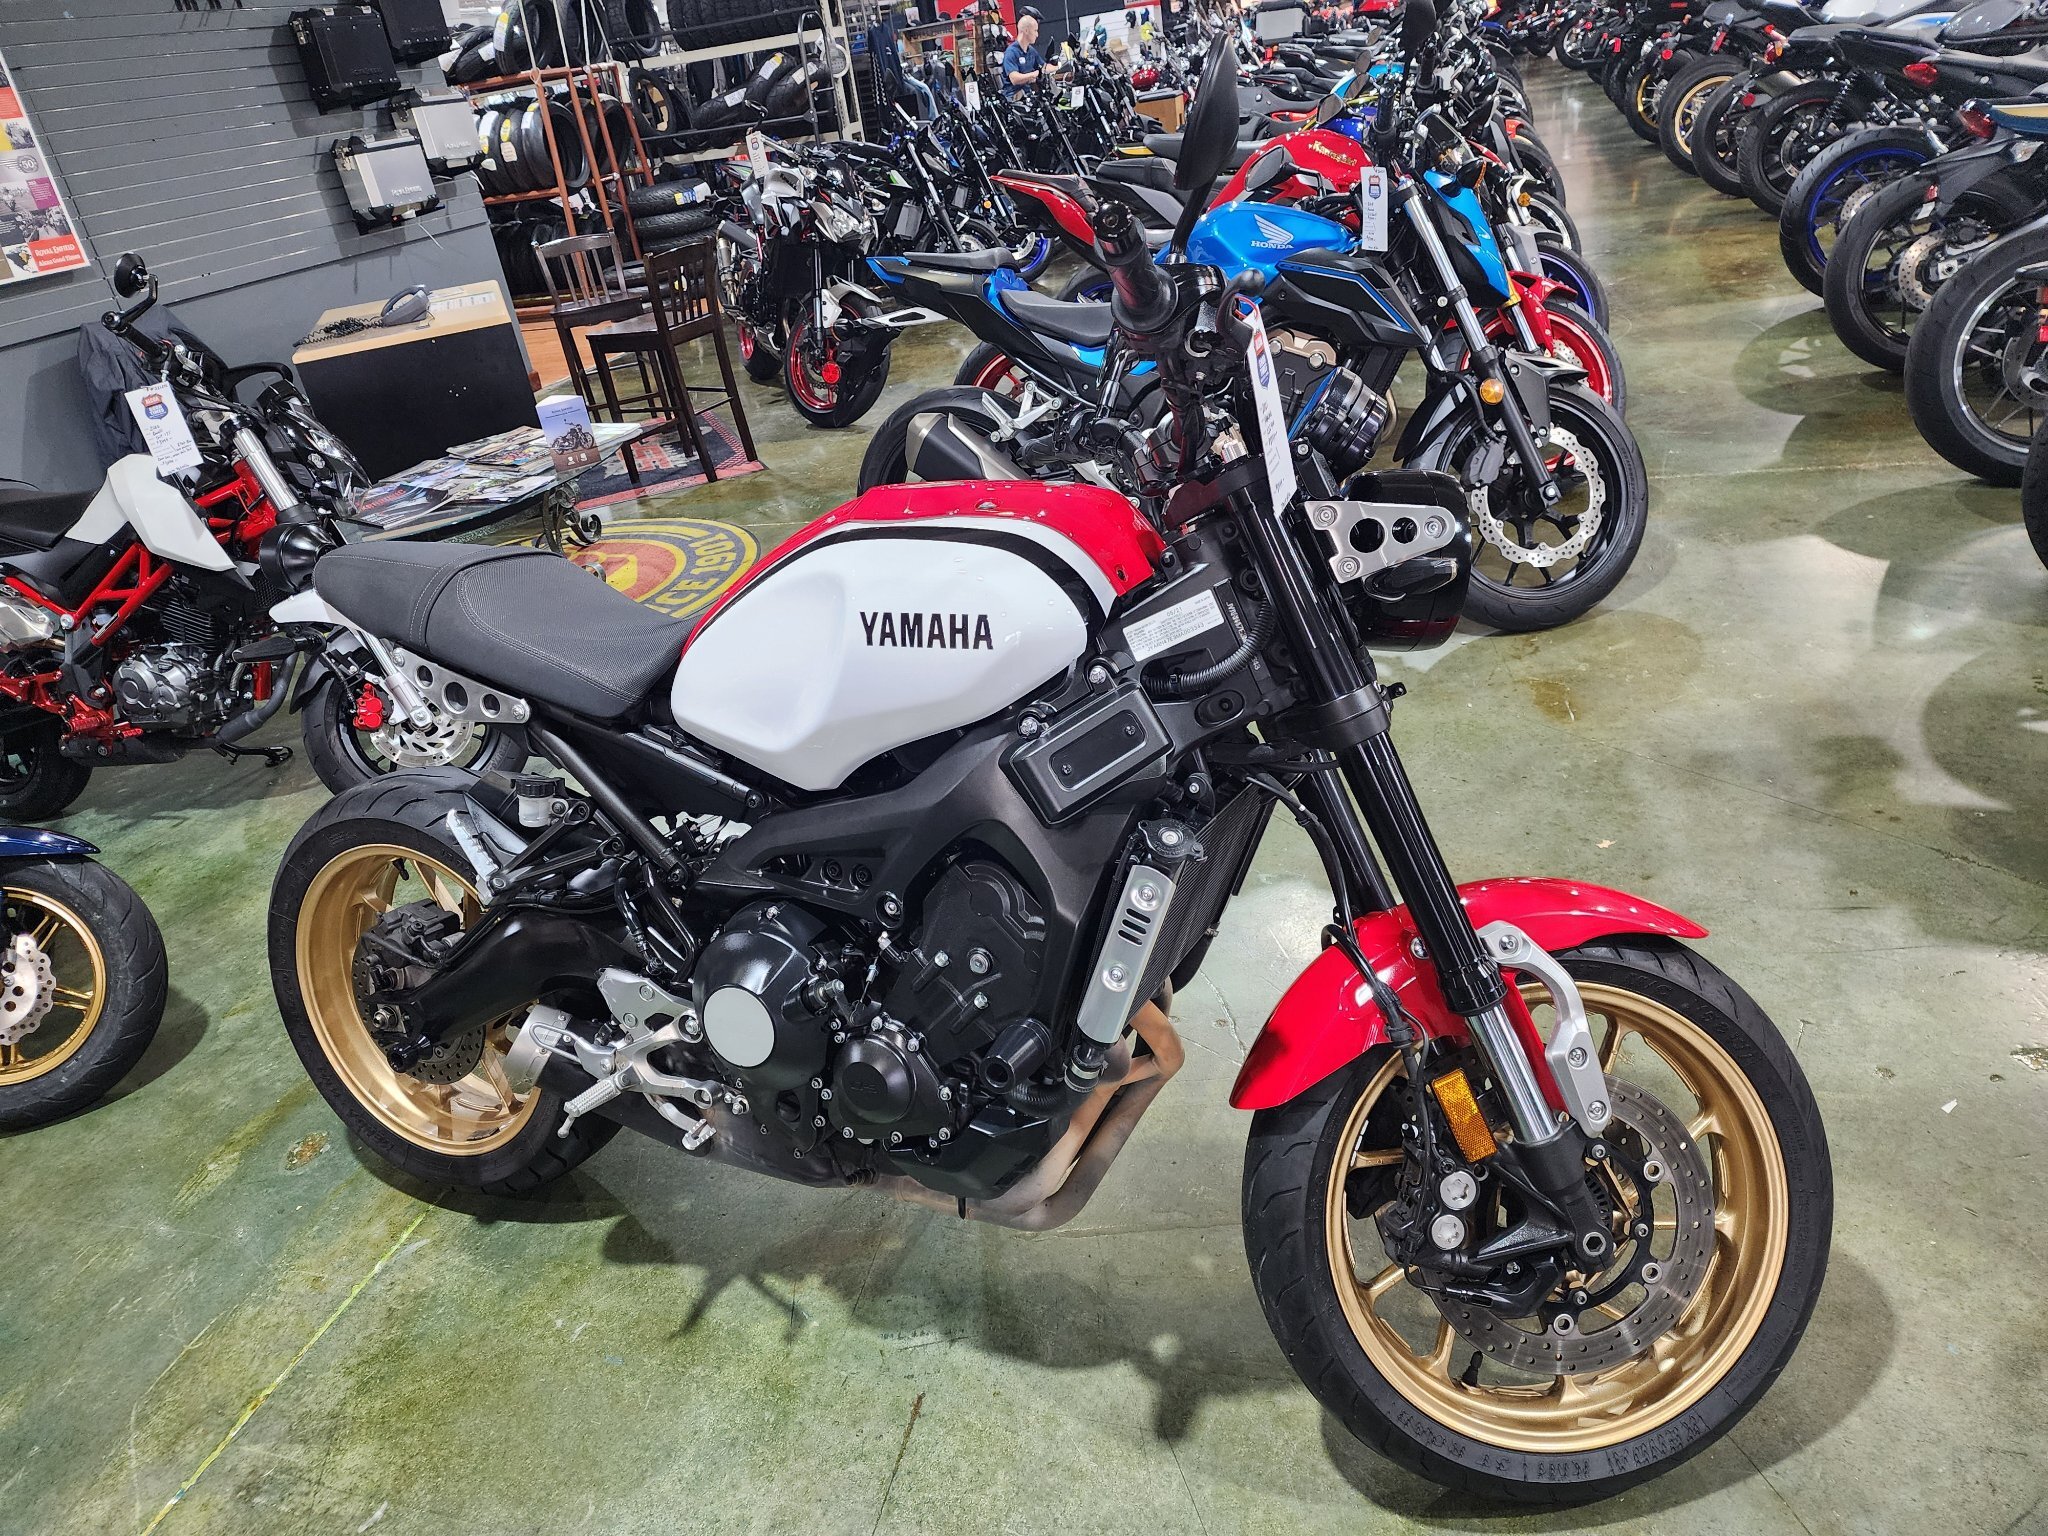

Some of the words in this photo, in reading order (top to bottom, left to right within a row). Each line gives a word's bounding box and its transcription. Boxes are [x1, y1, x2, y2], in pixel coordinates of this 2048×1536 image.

[1250, 240, 1295, 250] HONDA
[688, 532, 738, 576] 1901
[859, 611, 994, 650] YAMAHA
